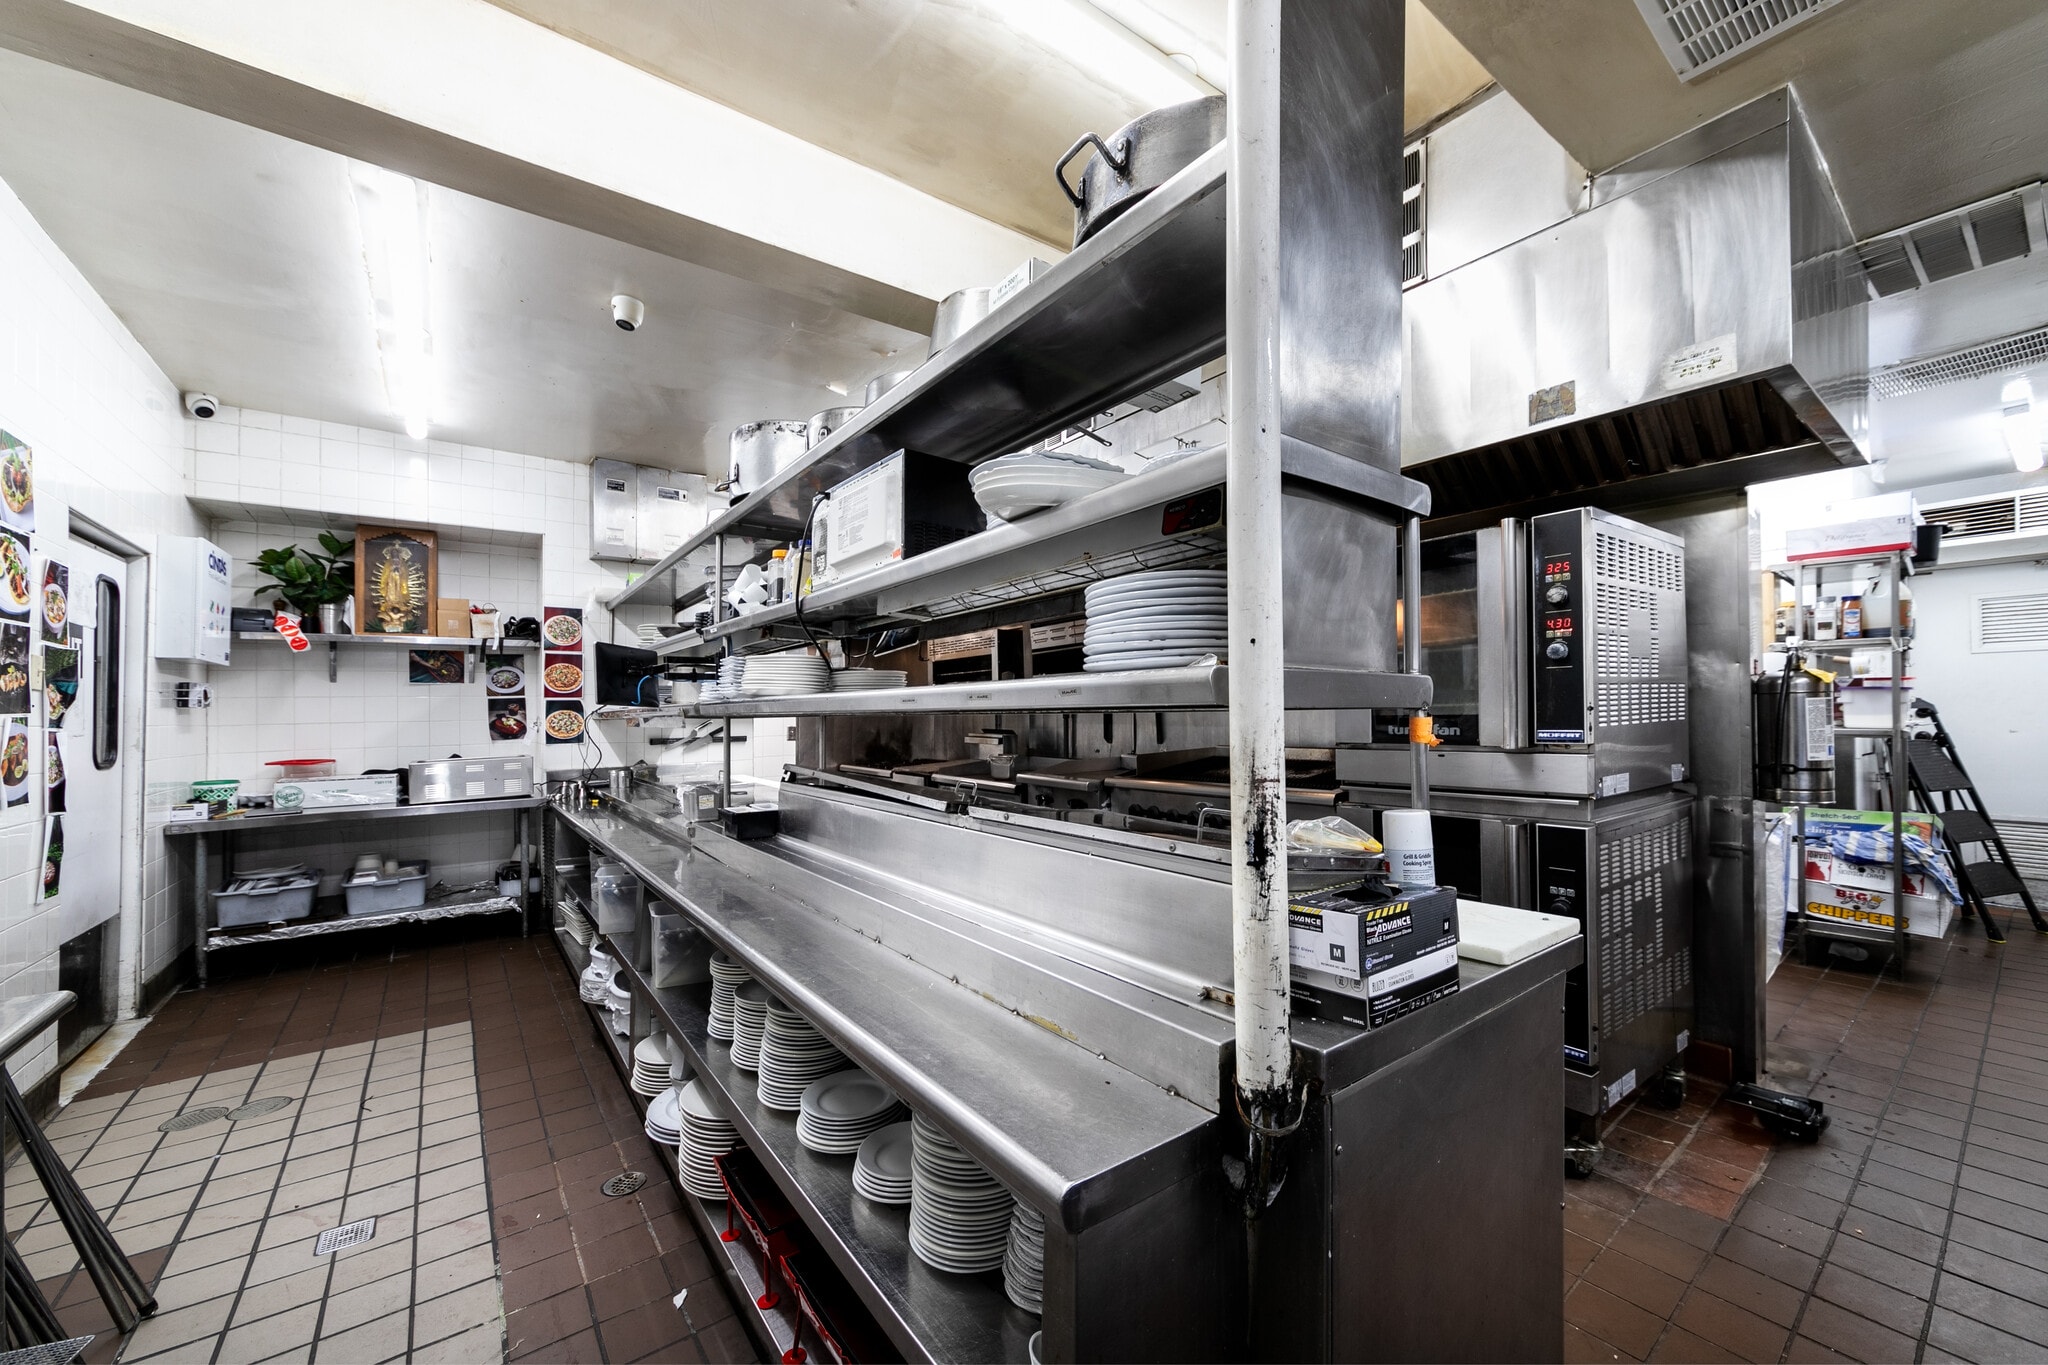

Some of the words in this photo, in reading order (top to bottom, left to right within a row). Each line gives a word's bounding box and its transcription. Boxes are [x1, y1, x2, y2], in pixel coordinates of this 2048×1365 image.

[208, 549, 227, 577] CINTAS
[1546, 561, 1570, 574] 325
[1388, 723, 1461, 736] turfan
[1538, 731, 1581, 739] MOFFAT
[1836, 888, 1868, 902] BIG
[1289, 914, 1322, 926] DVANCE
[1807, 902, 1910, 930] CHIPPERS
[1366, 926, 1377, 934] Black
[1375, 916, 1412, 937] ADVANCE
[1444, 921, 1449, 931] M
[1366, 935, 1383, 946] NITRILE
[1333, 947, 1342, 958] M
